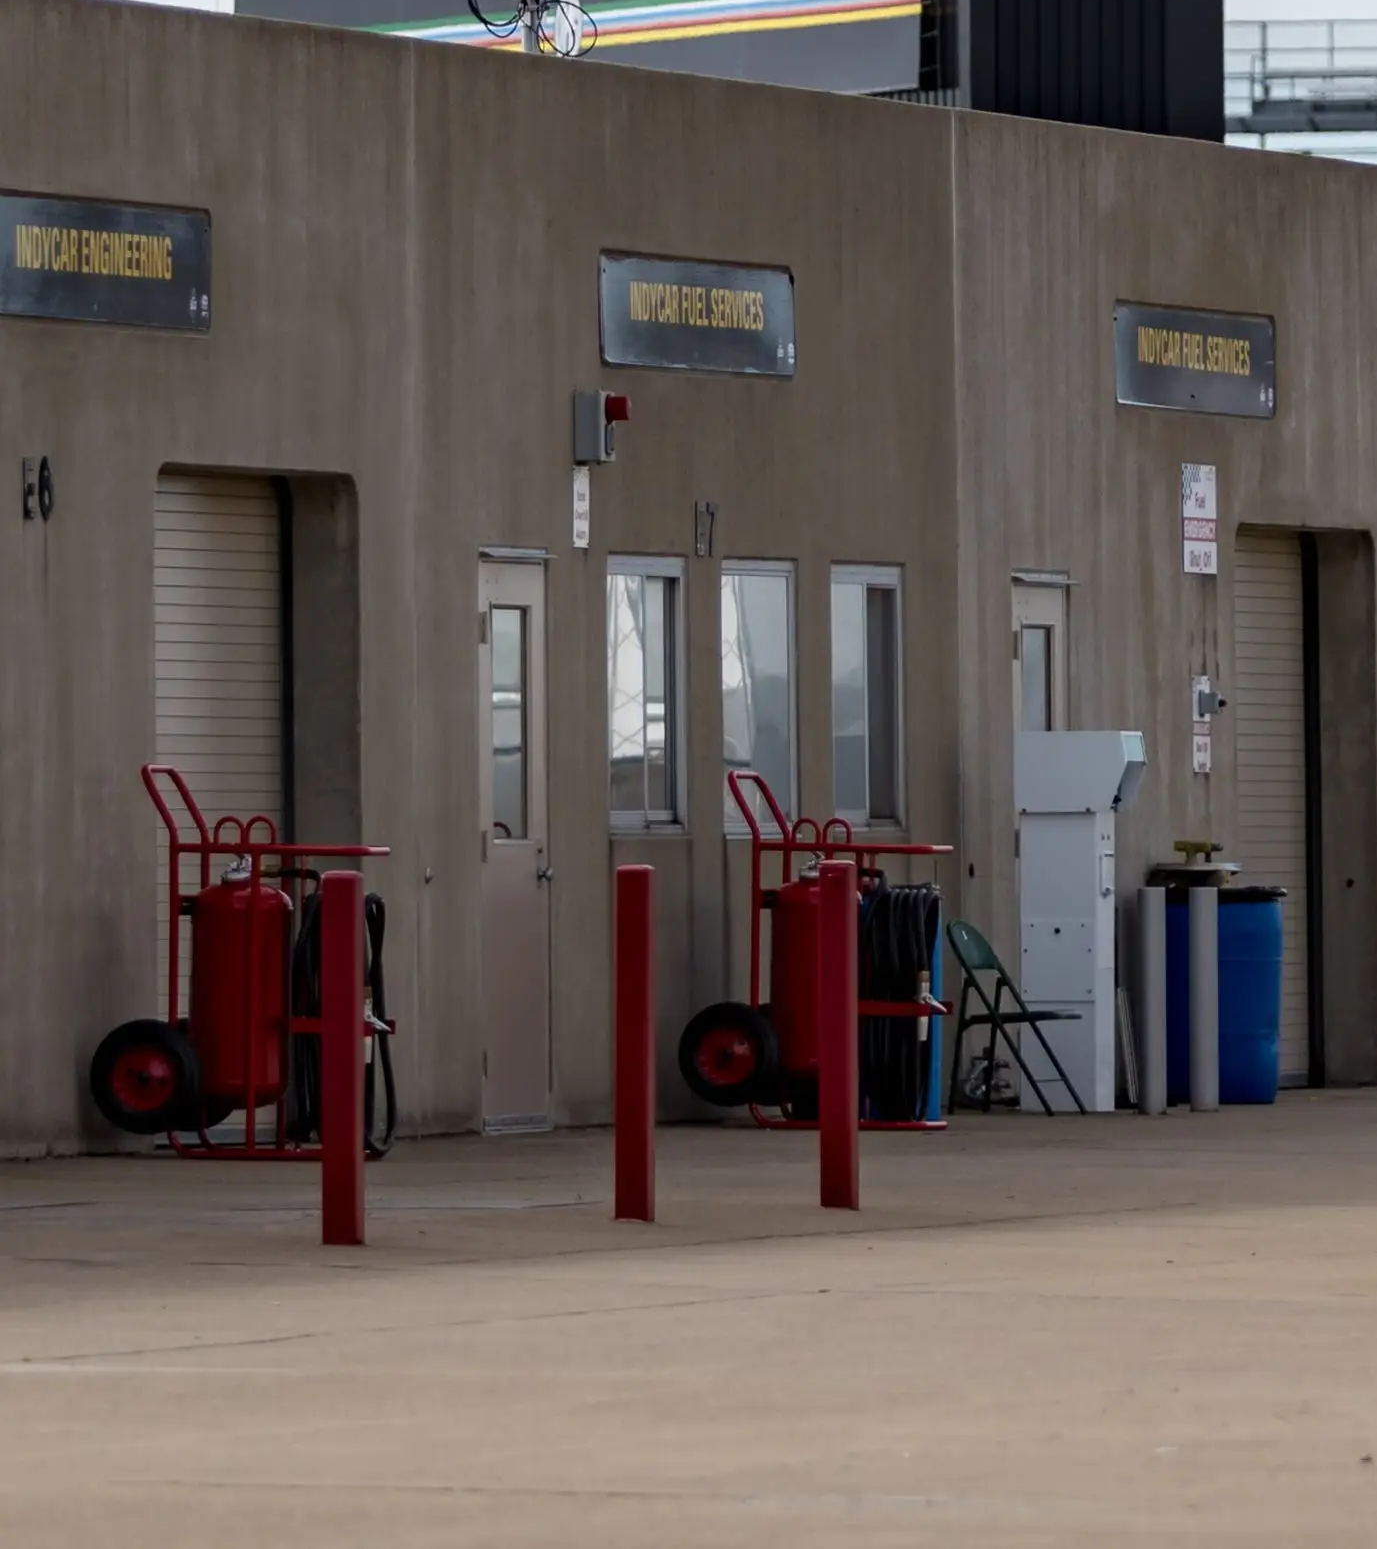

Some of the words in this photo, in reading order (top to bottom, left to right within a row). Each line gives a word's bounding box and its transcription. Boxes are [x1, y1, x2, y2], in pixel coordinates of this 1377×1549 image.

[15, 224, 79, 273] INDYCAR
[81, 228, 173, 281] ENGINEERING
[629, 280, 680, 325] INDYCAR
[681, 284, 709, 327] FUEL
[710, 287, 765, 331] SERVICES
[1137, 325, 1182, 367] INDYCAR
[1182, 331, 1205, 371] FUEL
[1206, 335, 1251, 376] SERVICES
